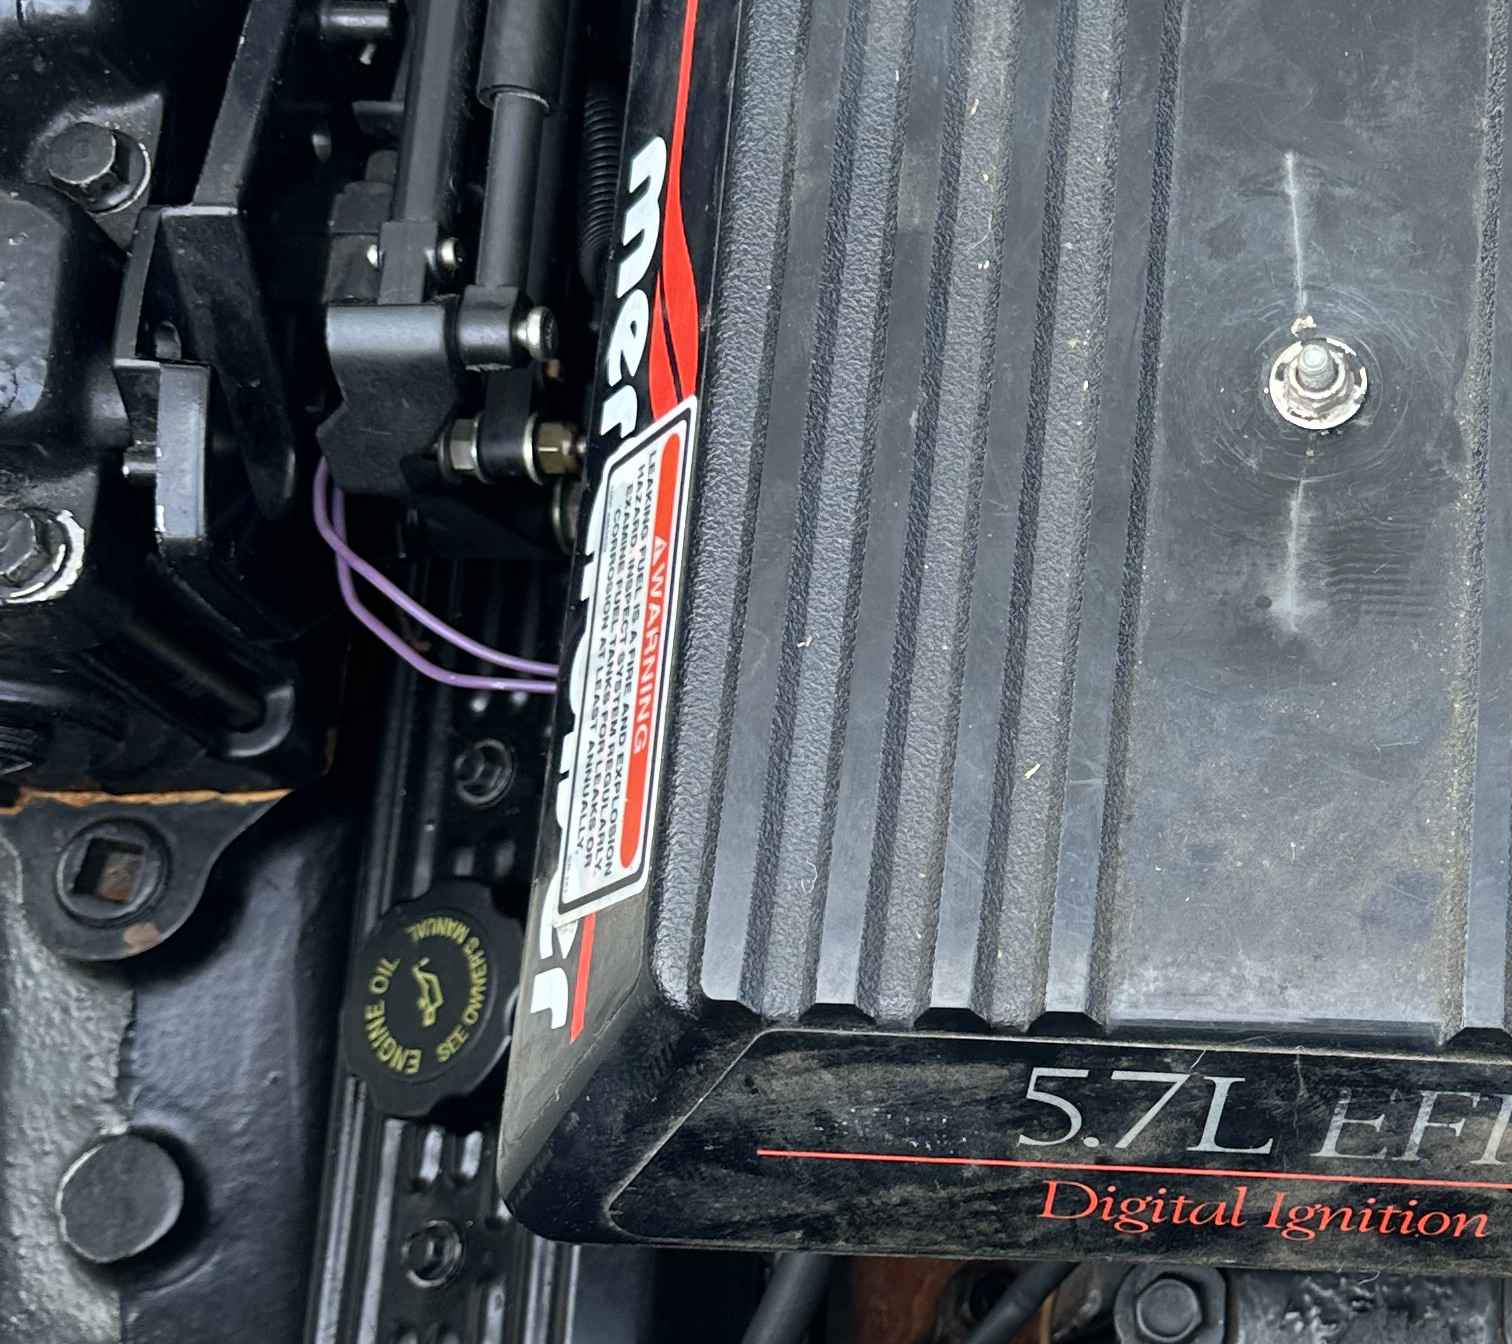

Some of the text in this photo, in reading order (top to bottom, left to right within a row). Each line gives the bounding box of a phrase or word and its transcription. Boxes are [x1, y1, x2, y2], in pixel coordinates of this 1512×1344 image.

[600, 508, 622, 630] CORROSION
[620, 559, 636, 654] INSPECT
[583, 484, 634, 869] EXAMINE FUEL TANKS FOR LEAKS OR
[596, 641, 608, 659] AT
[604, 449, 657, 876] LEAKING FUEL IS A FIRE AND EXPLOSION
[633, 561, 667, 754] WARNING
[590, 665, 606, 730] LEAST
[609, 653, 626, 738] SYSTEM
[404, 916, 471, 945] MANUAL
[364, 958, 422, 1074] ENGINE OIL
[436, 1024, 470, 1063] SEE
[1017, 1066, 1274, 1155] 5.7L
[1038, 1180, 1488, 1242] Digital Ignition
